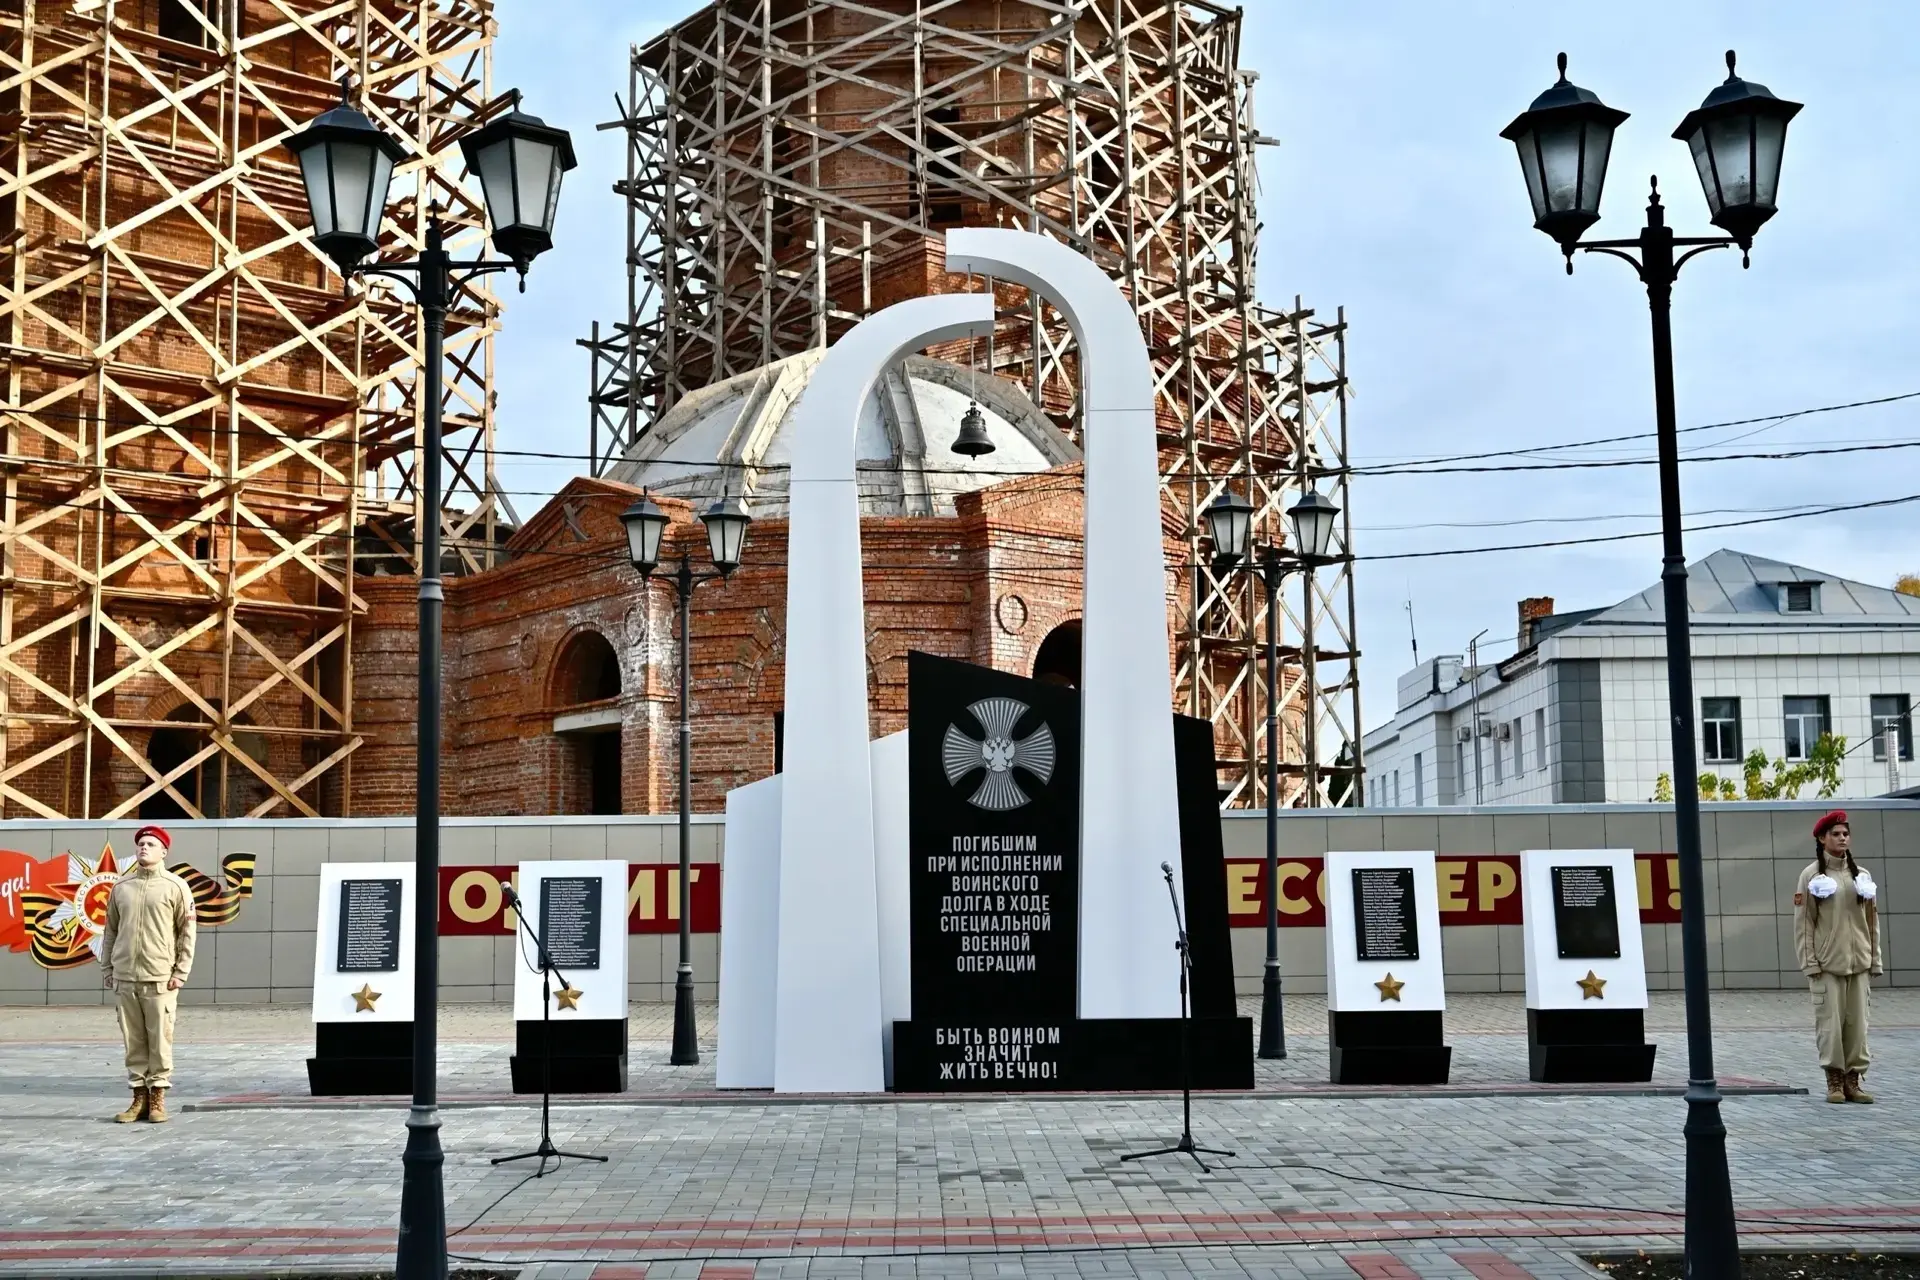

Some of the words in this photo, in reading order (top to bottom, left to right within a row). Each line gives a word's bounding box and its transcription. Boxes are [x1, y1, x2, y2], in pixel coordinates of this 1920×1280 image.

[952, 835, 1037, 852] ПОГИБШИМ
[928, 855, 957, 872] ПРИ
[961, 855, 1062, 872] ИСПОЛНЕНИИ
[0, 862, 30, 918] да!
[952, 875, 1039, 892] ВОИНСКОГО
[940, 895, 993, 913] ДОЛГА
[996, 895, 1006, 911] В
[1009, 894, 1050, 912] ХОДЕ
[940, 912, 1051, 932] СПЕЦИАЛЬНОЙ
[961, 932, 1030, 952] ВОЕННОЙ
[957, 954, 1036, 973] ОПЕРАЦИИ
[936, 1027, 983, 1045] БЫТЬ
[988, 1027, 1060, 1044] ВОИНОМ
[964, 1044, 1032, 1062] ЗНАЧИТ
[939, 1062, 989, 1080] ЖИТЬ
[994, 1061, 1058, 1079] ВЕЧНО!
